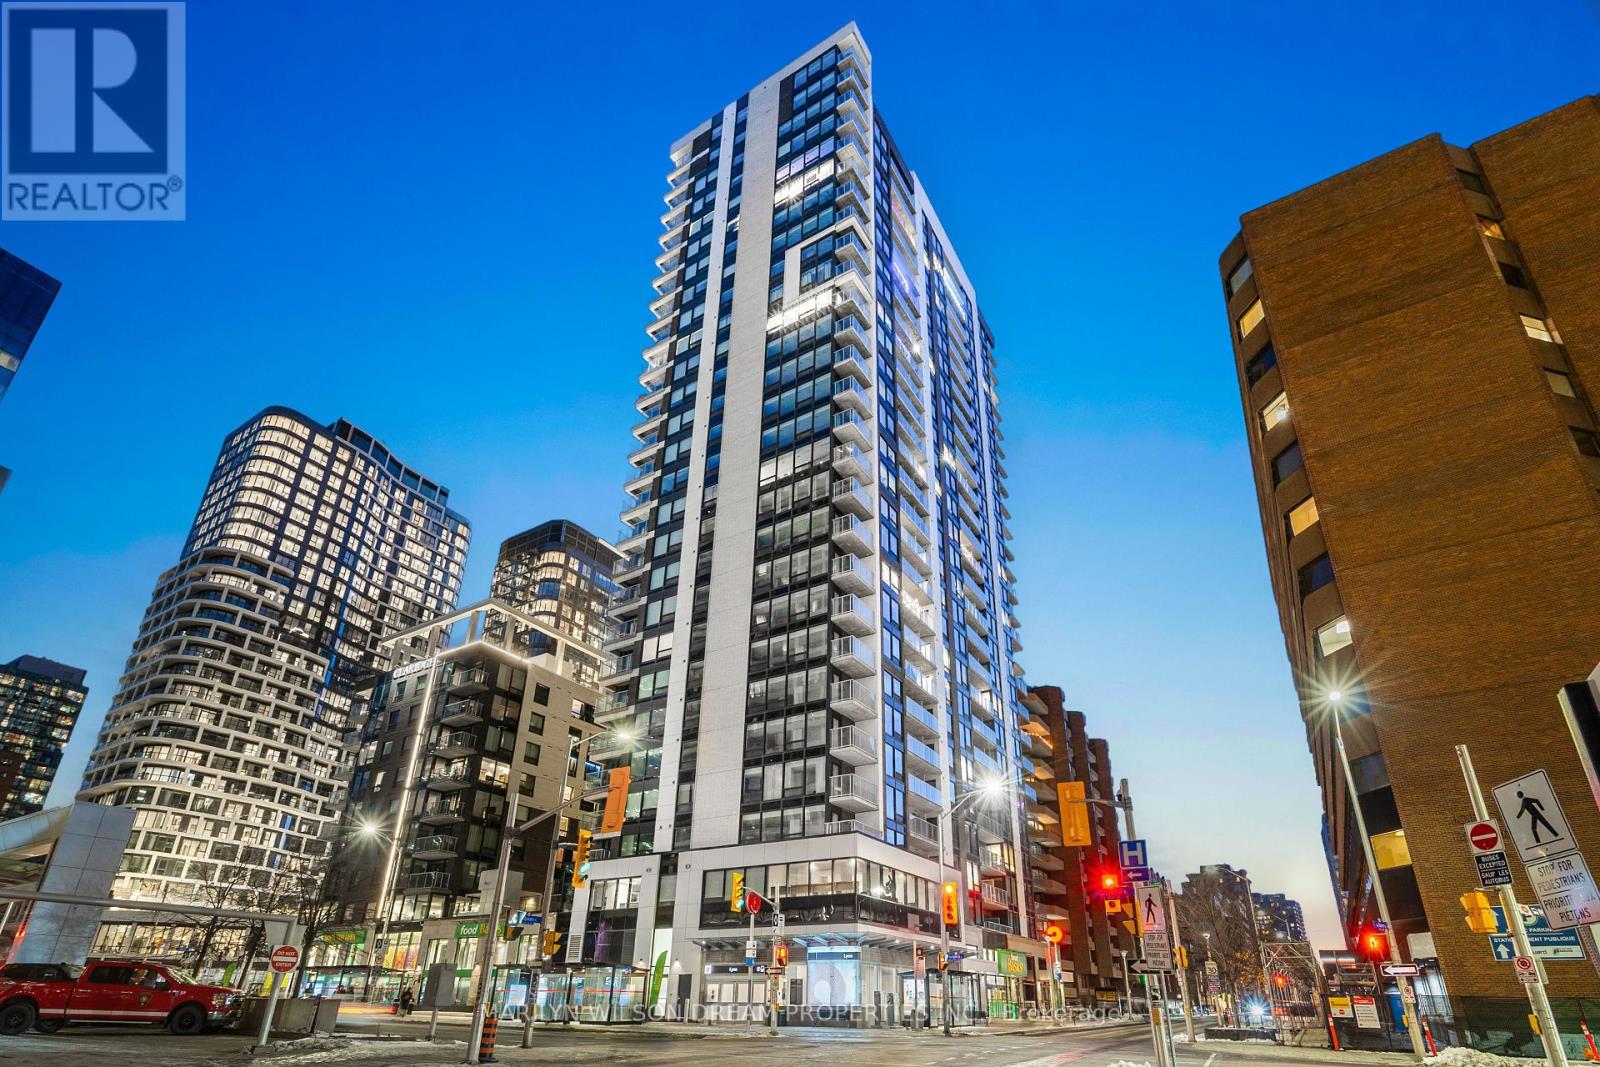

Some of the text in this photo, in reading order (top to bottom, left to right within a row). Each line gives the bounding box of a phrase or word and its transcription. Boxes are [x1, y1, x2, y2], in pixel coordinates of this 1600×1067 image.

[1122, 842, 1144, 866] H
[1537, 860, 1574, 877] STOP FOR
[1537, 872, 1586, 892] PEDESTRIANS
[460, 925, 479, 935] food
